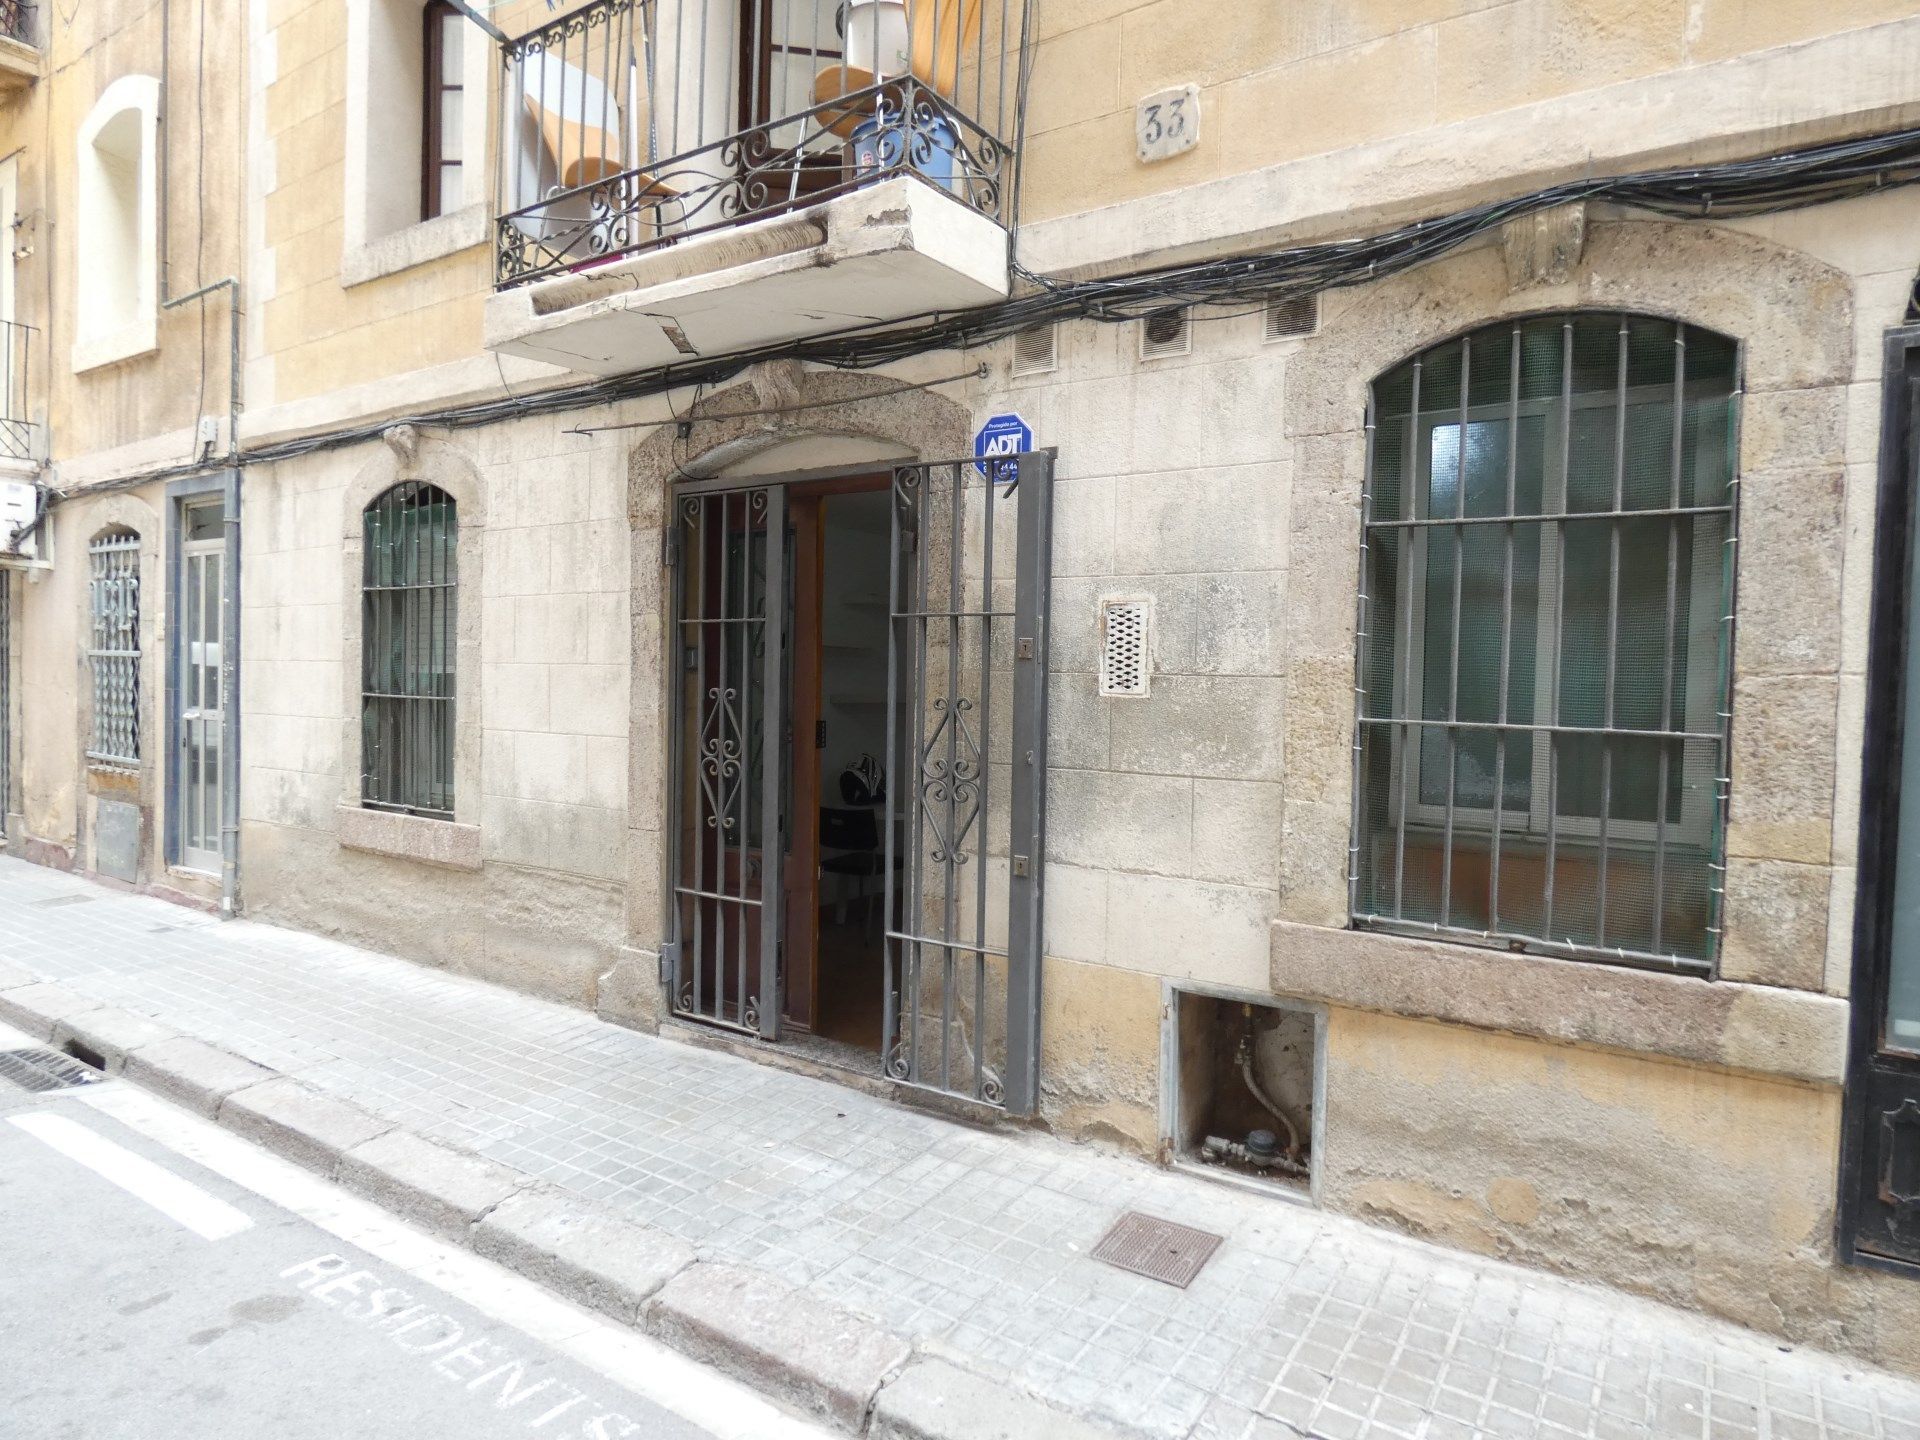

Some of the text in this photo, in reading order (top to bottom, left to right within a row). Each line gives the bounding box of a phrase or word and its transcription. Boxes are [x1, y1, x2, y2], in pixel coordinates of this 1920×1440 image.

[1144, 98, 1184, 144] 33
[985, 433, 1022, 457] ADT
[279, 1252, 640, 1440] RESIDENTS
